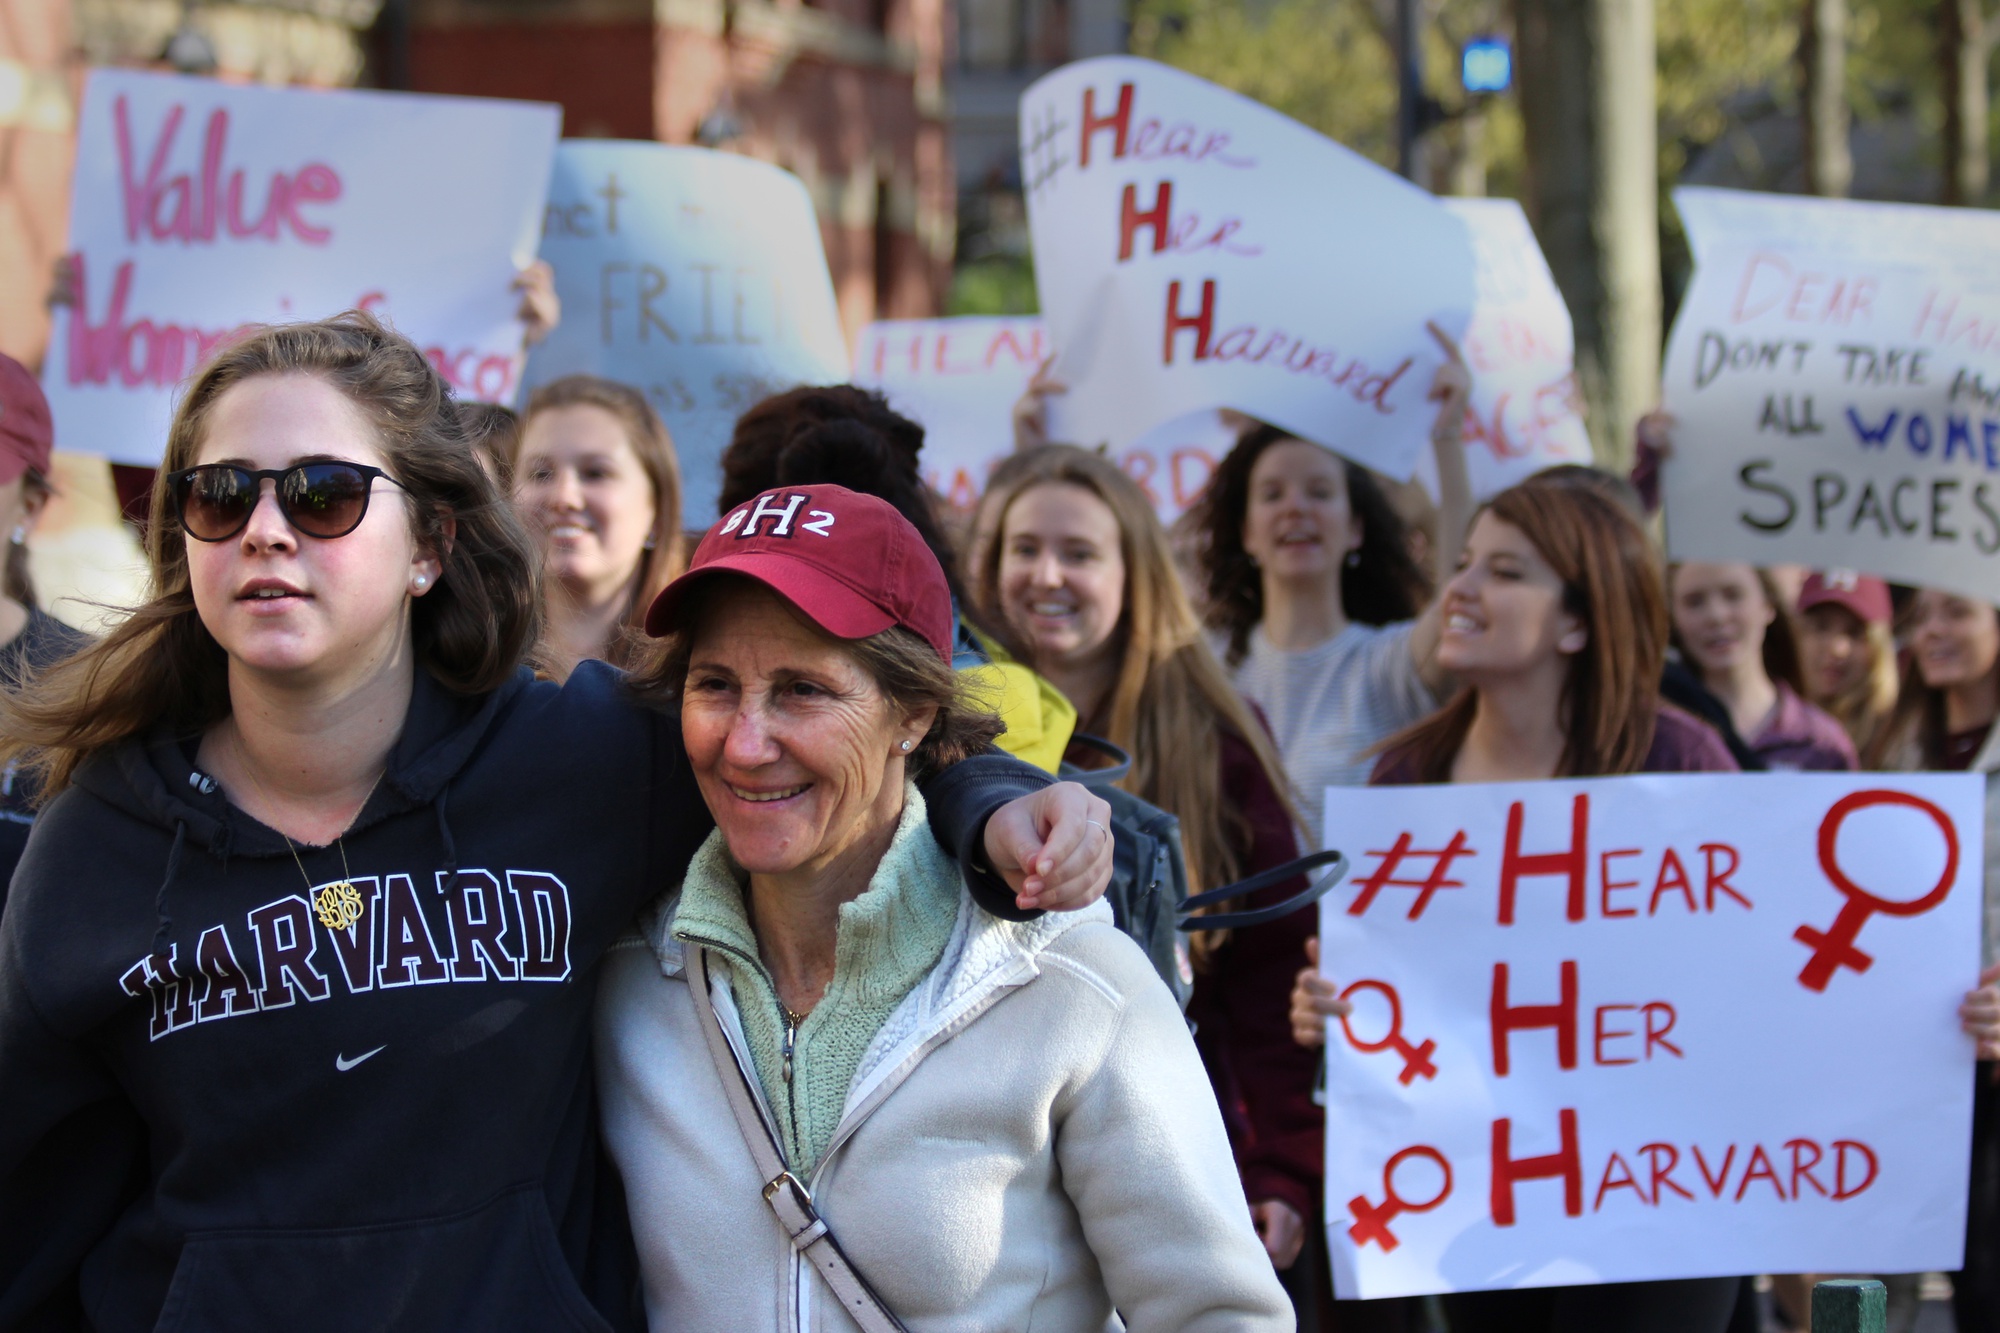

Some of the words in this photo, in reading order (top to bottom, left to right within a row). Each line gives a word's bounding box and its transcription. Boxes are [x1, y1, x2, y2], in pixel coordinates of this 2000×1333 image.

[114, 95, 344, 244] Value
[1118, 181, 1262, 261] Her
[600, 261, 786, 346] FRIE
[1164, 279, 1414, 414] Harvard
[1913, 287, 2000, 352] HA
[1837, 344, 1930, 385] TAKE
[1758, 394, 1824, 436] ALL
[1740, 460, 2000, 556] SPACES
[119, 868, 573, 1042] HARVARD
[1490, 960, 1684, 1077] HER
[1490, 1108, 1880, 1227] HARVARD
